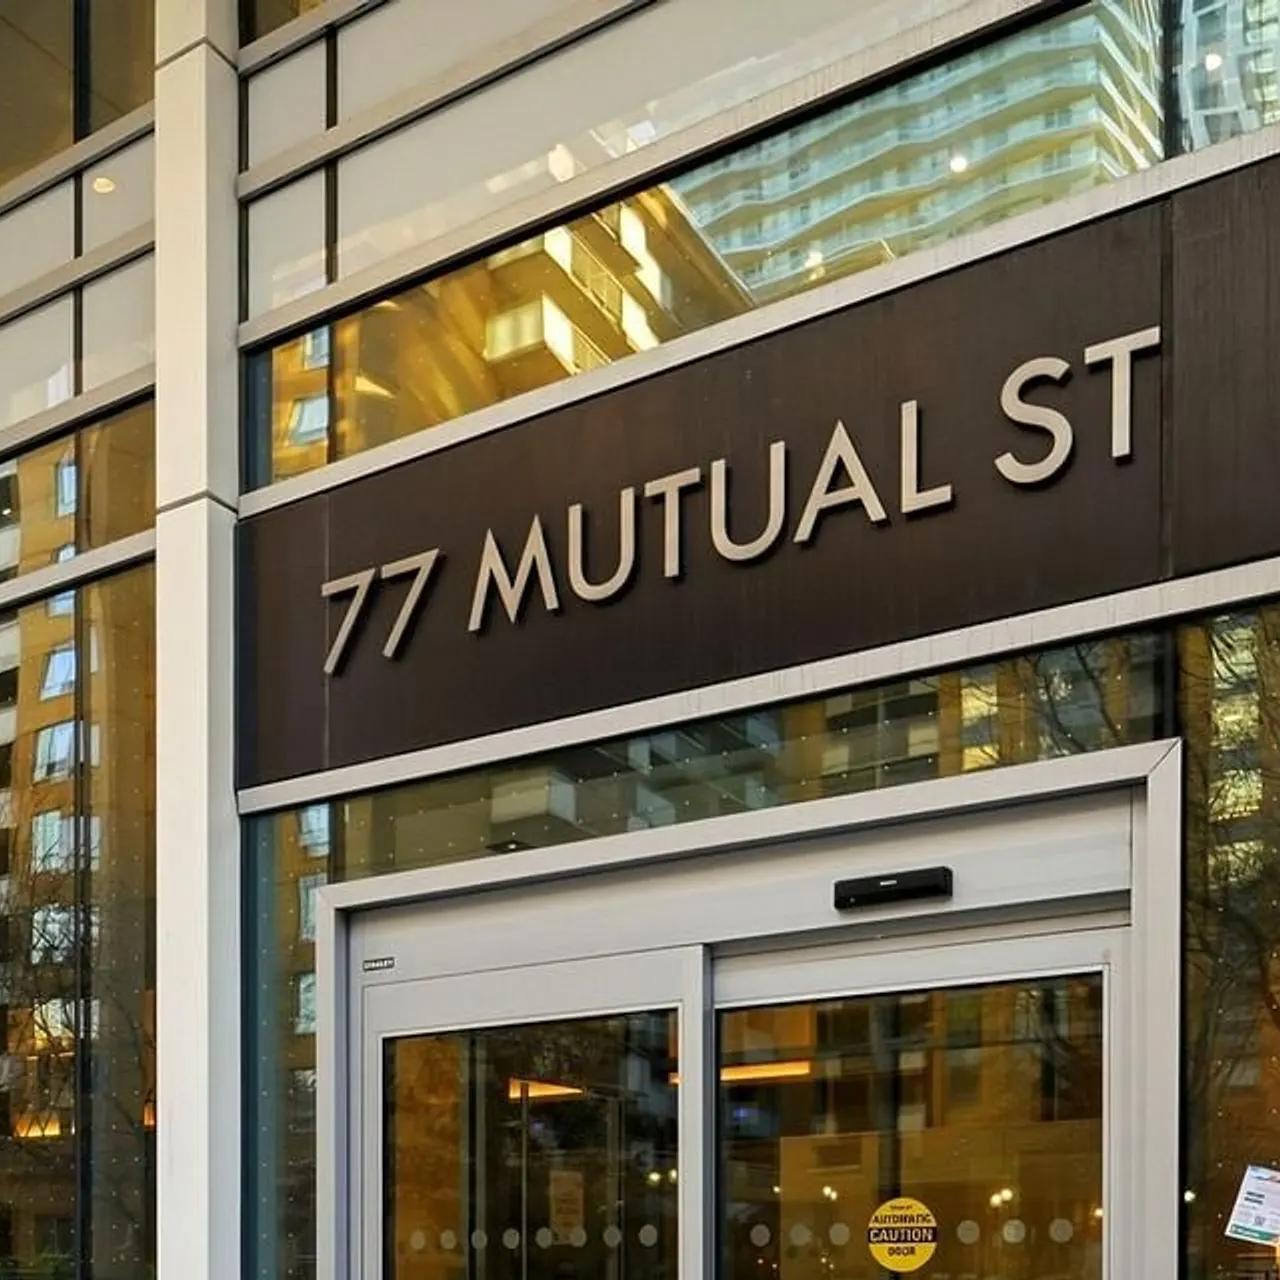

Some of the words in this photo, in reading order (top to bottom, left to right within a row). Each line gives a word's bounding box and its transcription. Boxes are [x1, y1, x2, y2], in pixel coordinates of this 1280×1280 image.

[320, 547, 440, 674] 77
[468, 400, 953, 632] MUTUAL
[994, 325, 1162, 483] ST
[870, 1227, 933, 1242] CAUTION
[887, 1246, 916, 1256] DOOR
